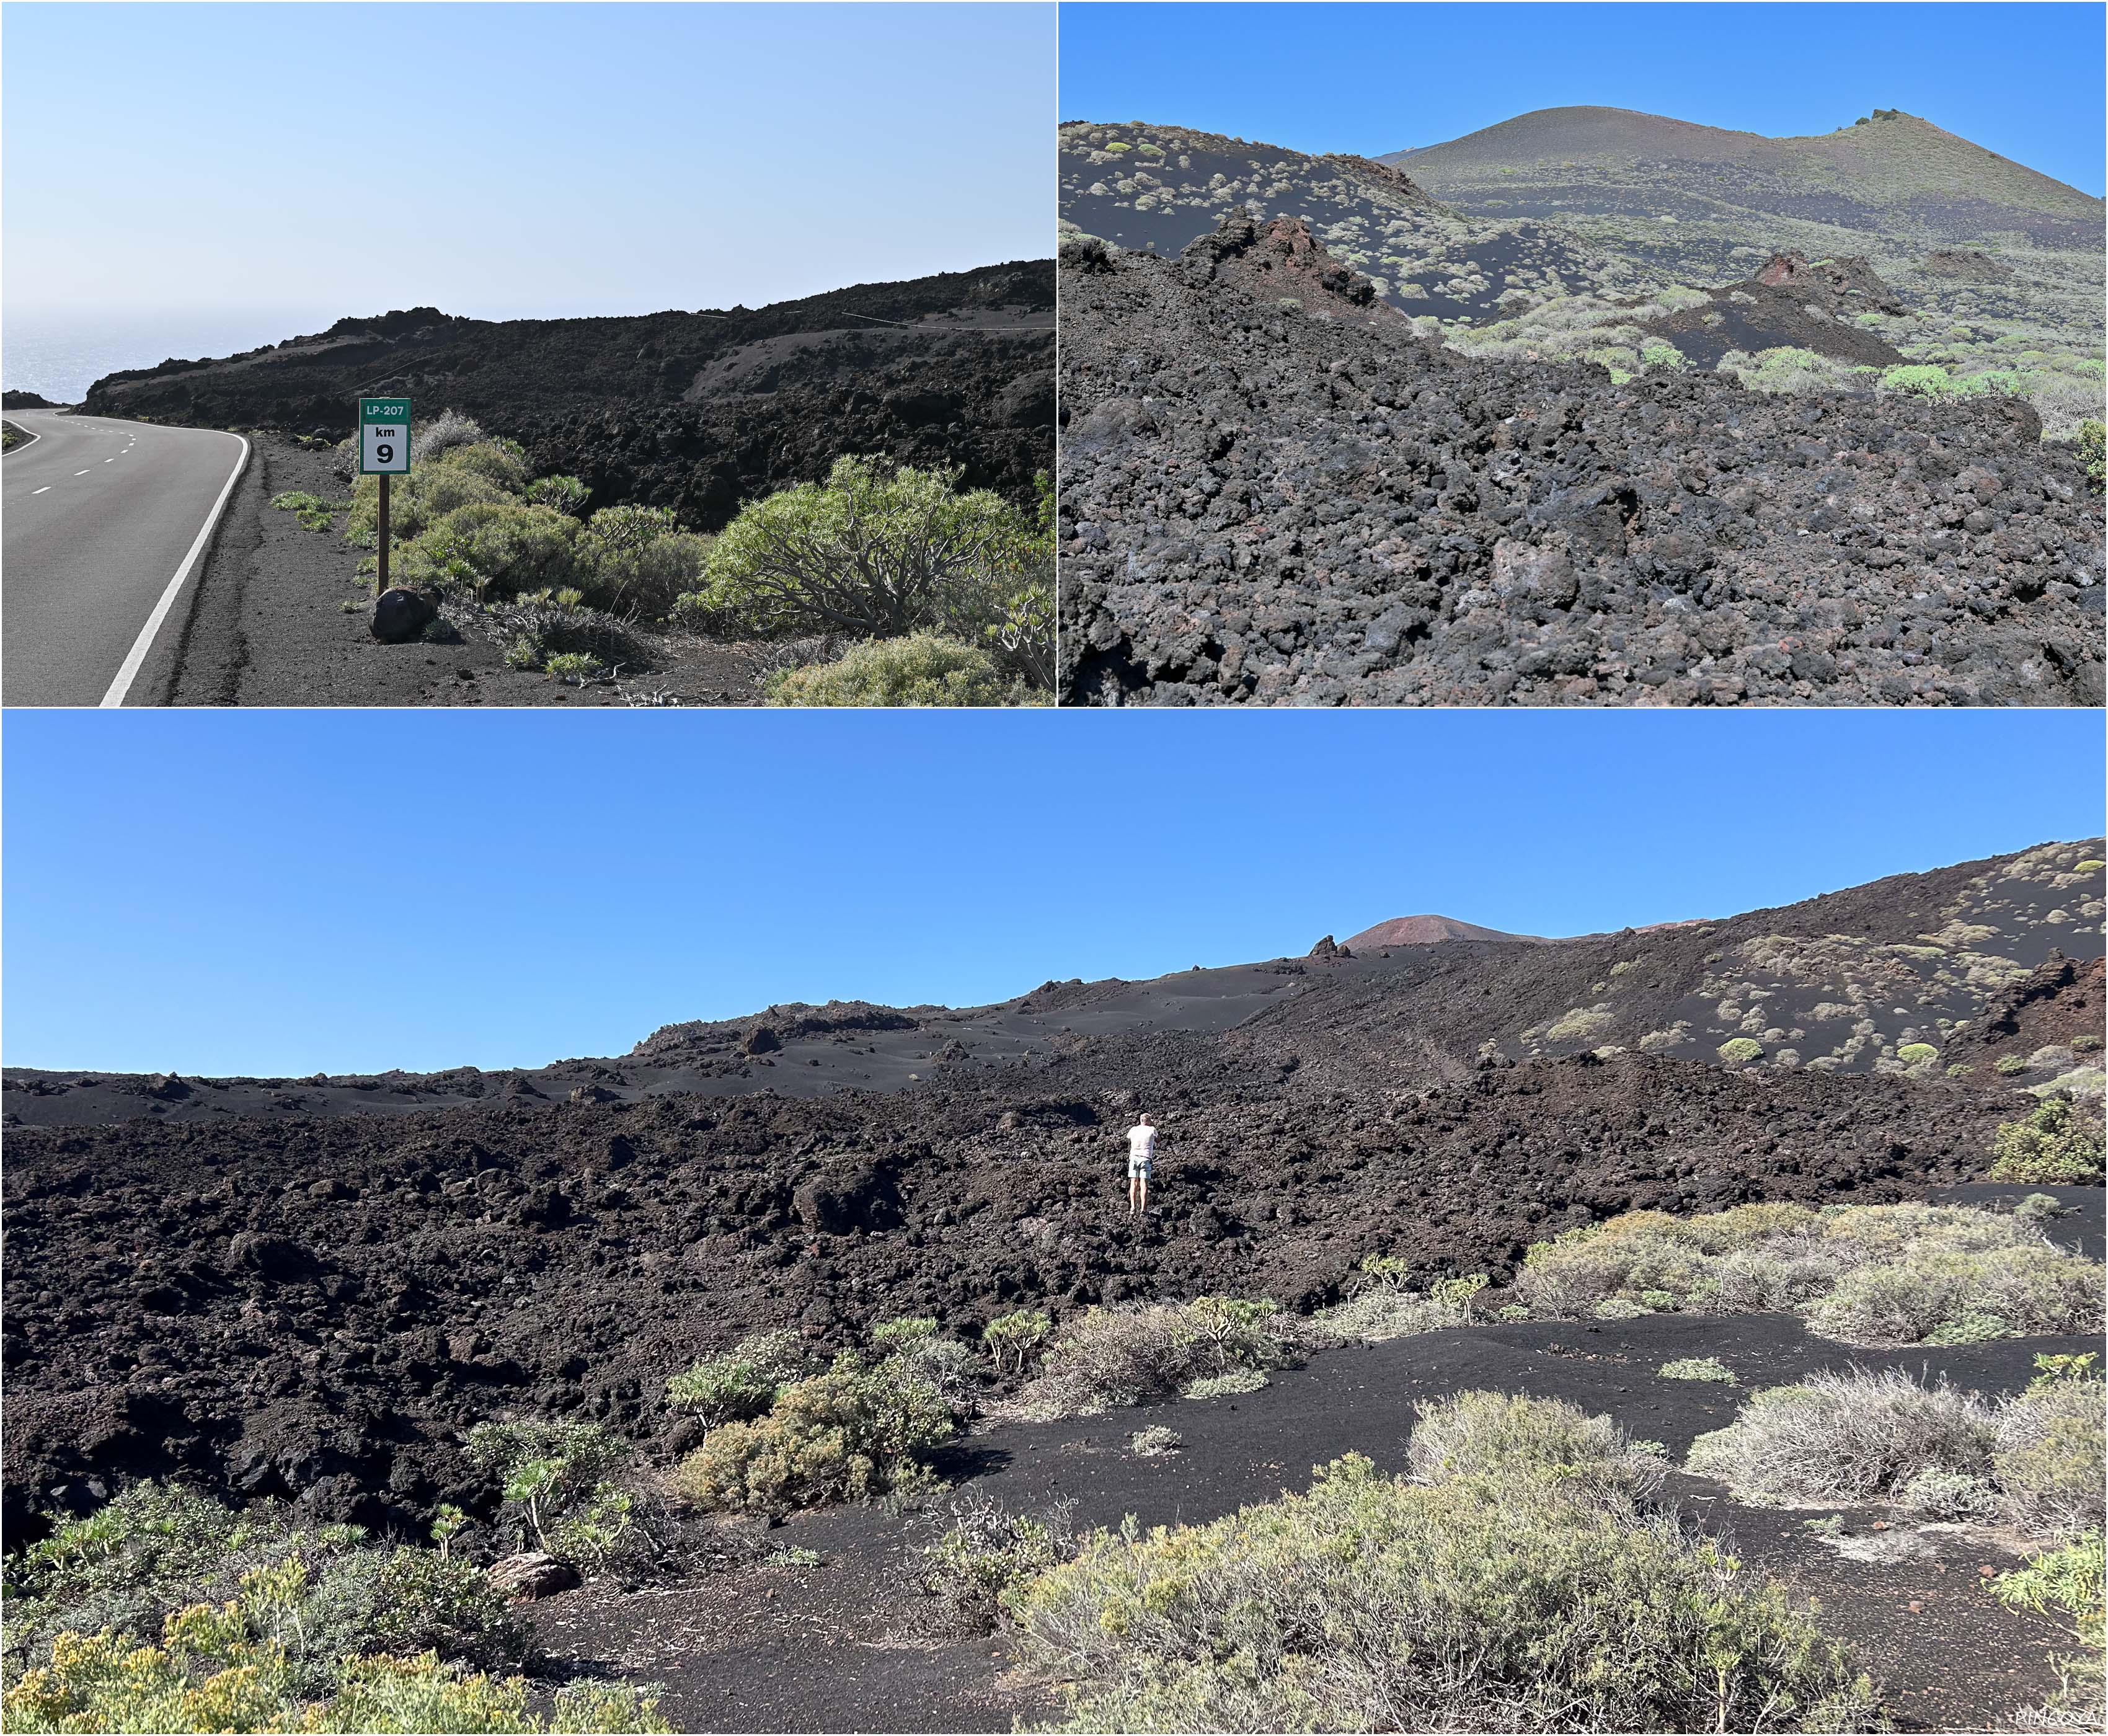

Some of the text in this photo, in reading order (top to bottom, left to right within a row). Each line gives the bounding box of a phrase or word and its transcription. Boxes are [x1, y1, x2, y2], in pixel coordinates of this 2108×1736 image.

[366, 405, 404, 415] LP-207
[375, 427, 395, 437] km
[376, 444, 394, 464] 9
